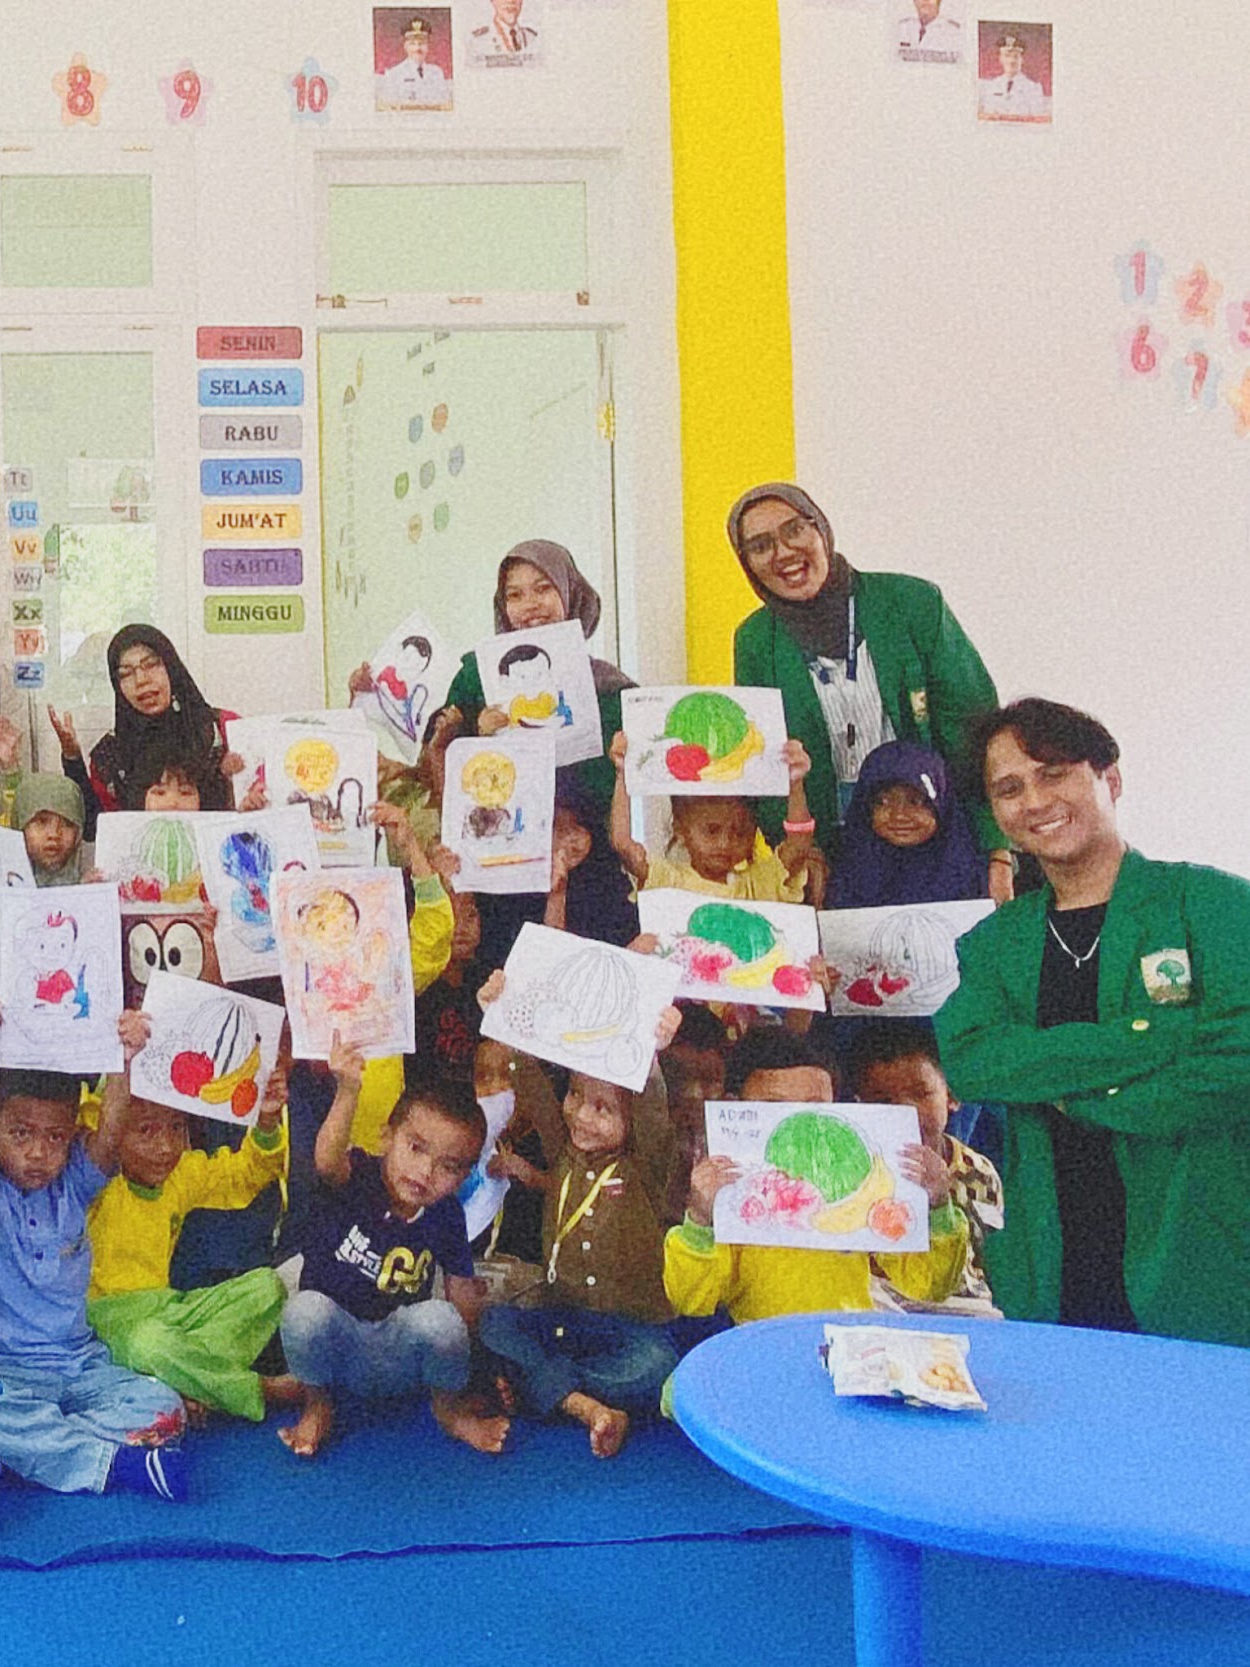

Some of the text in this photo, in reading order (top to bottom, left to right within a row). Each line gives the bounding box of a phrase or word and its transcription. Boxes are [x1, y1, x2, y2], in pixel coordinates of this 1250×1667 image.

[66, 65, 95, 117] 8
[173, 69, 202, 119] 9
[292, 73, 329, 114] 10
[1129, 251, 1210, 318] 1 2
[220, 335, 277, 351] SENIN
[1130, 324, 1210, 400] 6 7
[209, 379, 287, 396] SELASA
[224, 425, 280, 442] RABU
[220, 468, 284, 485] KAMIS
[11, 505, 38, 522] Uu
[216, 513, 287, 529] JUM'AT
[14, 540, 38, 555] Vv
[13, 604, 42, 621] Xx
[217, 604, 292, 621] MINGGU
[16, 666, 42, 682] Zz
